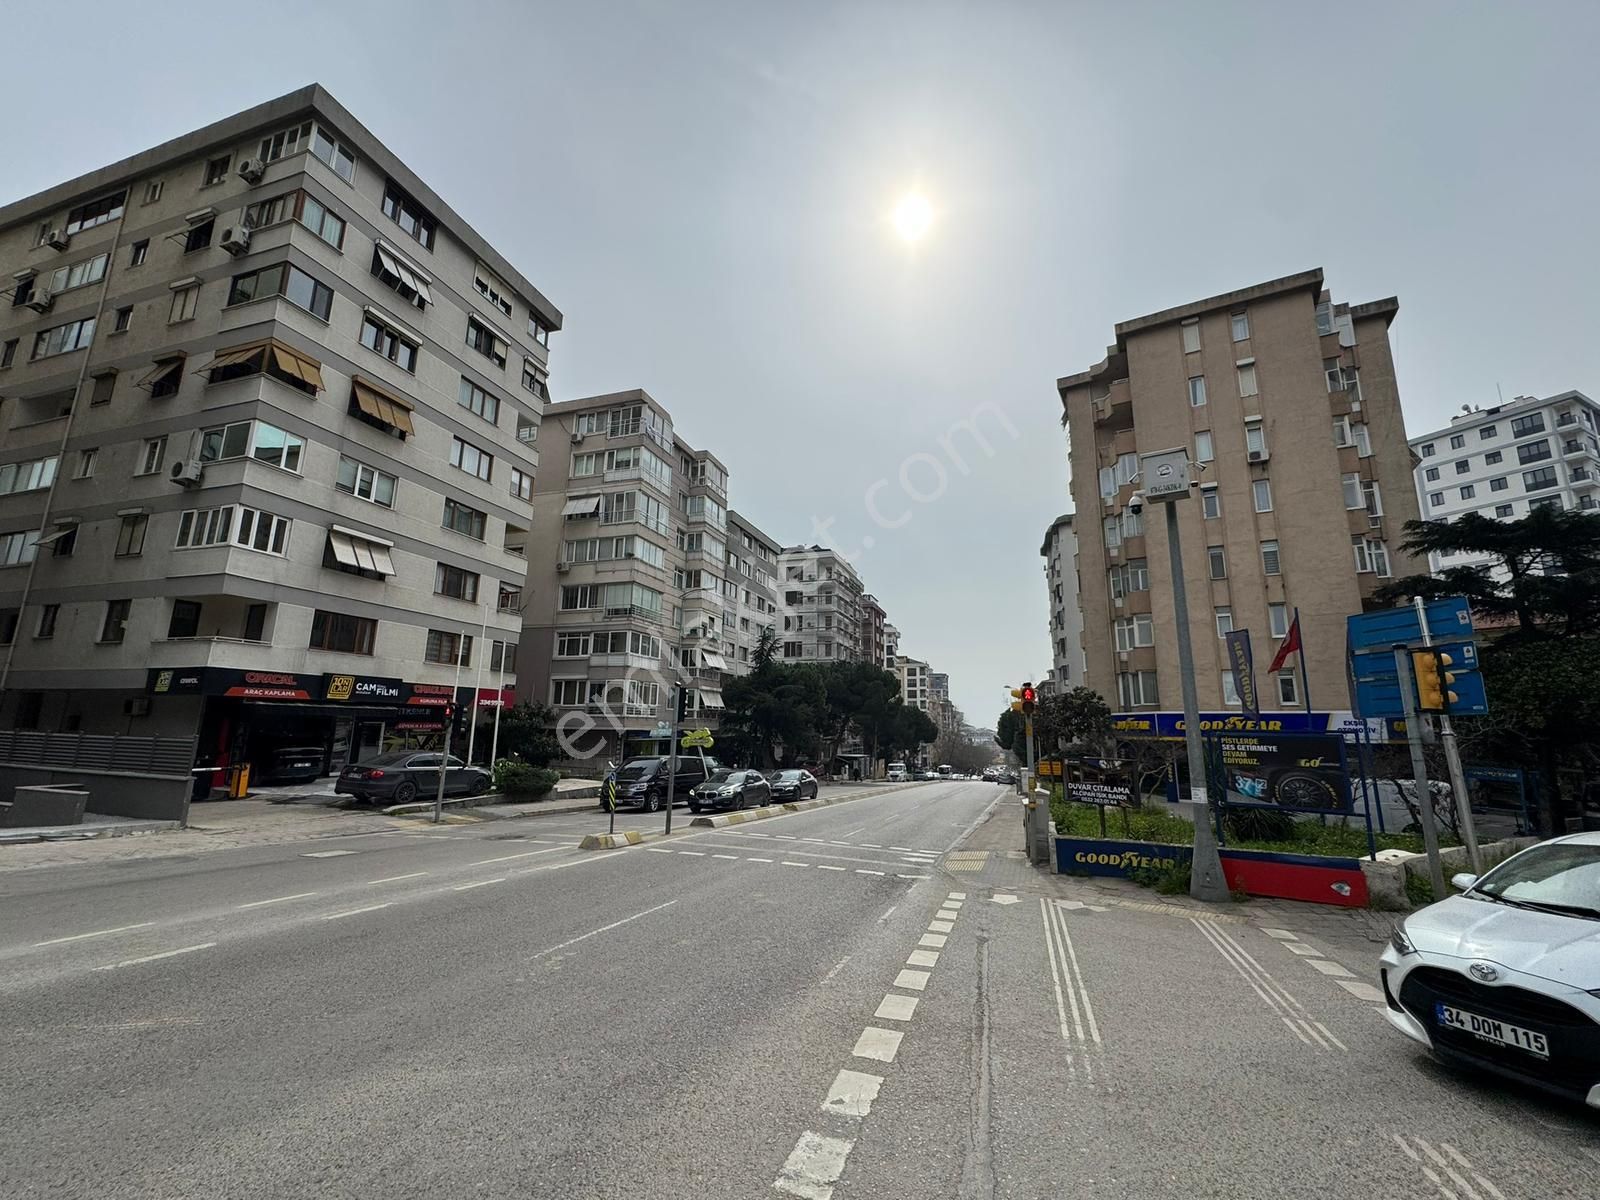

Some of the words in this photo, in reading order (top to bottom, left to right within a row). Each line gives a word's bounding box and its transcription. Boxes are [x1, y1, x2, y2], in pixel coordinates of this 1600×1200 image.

[355, 683, 377, 691] CAM
[376, 687, 399, 697] FİLMİ
[1175, 718, 1282, 731] GODYEAR
[1068, 782, 1092, 791] DUVAR
[1075, 852, 1175, 869] GOODYEAR
[1444, 1007, 1465, 1028] 34
[1471, 1015, 1504, 1040] DOM
[1511, 1027, 1546, 1053] 115
